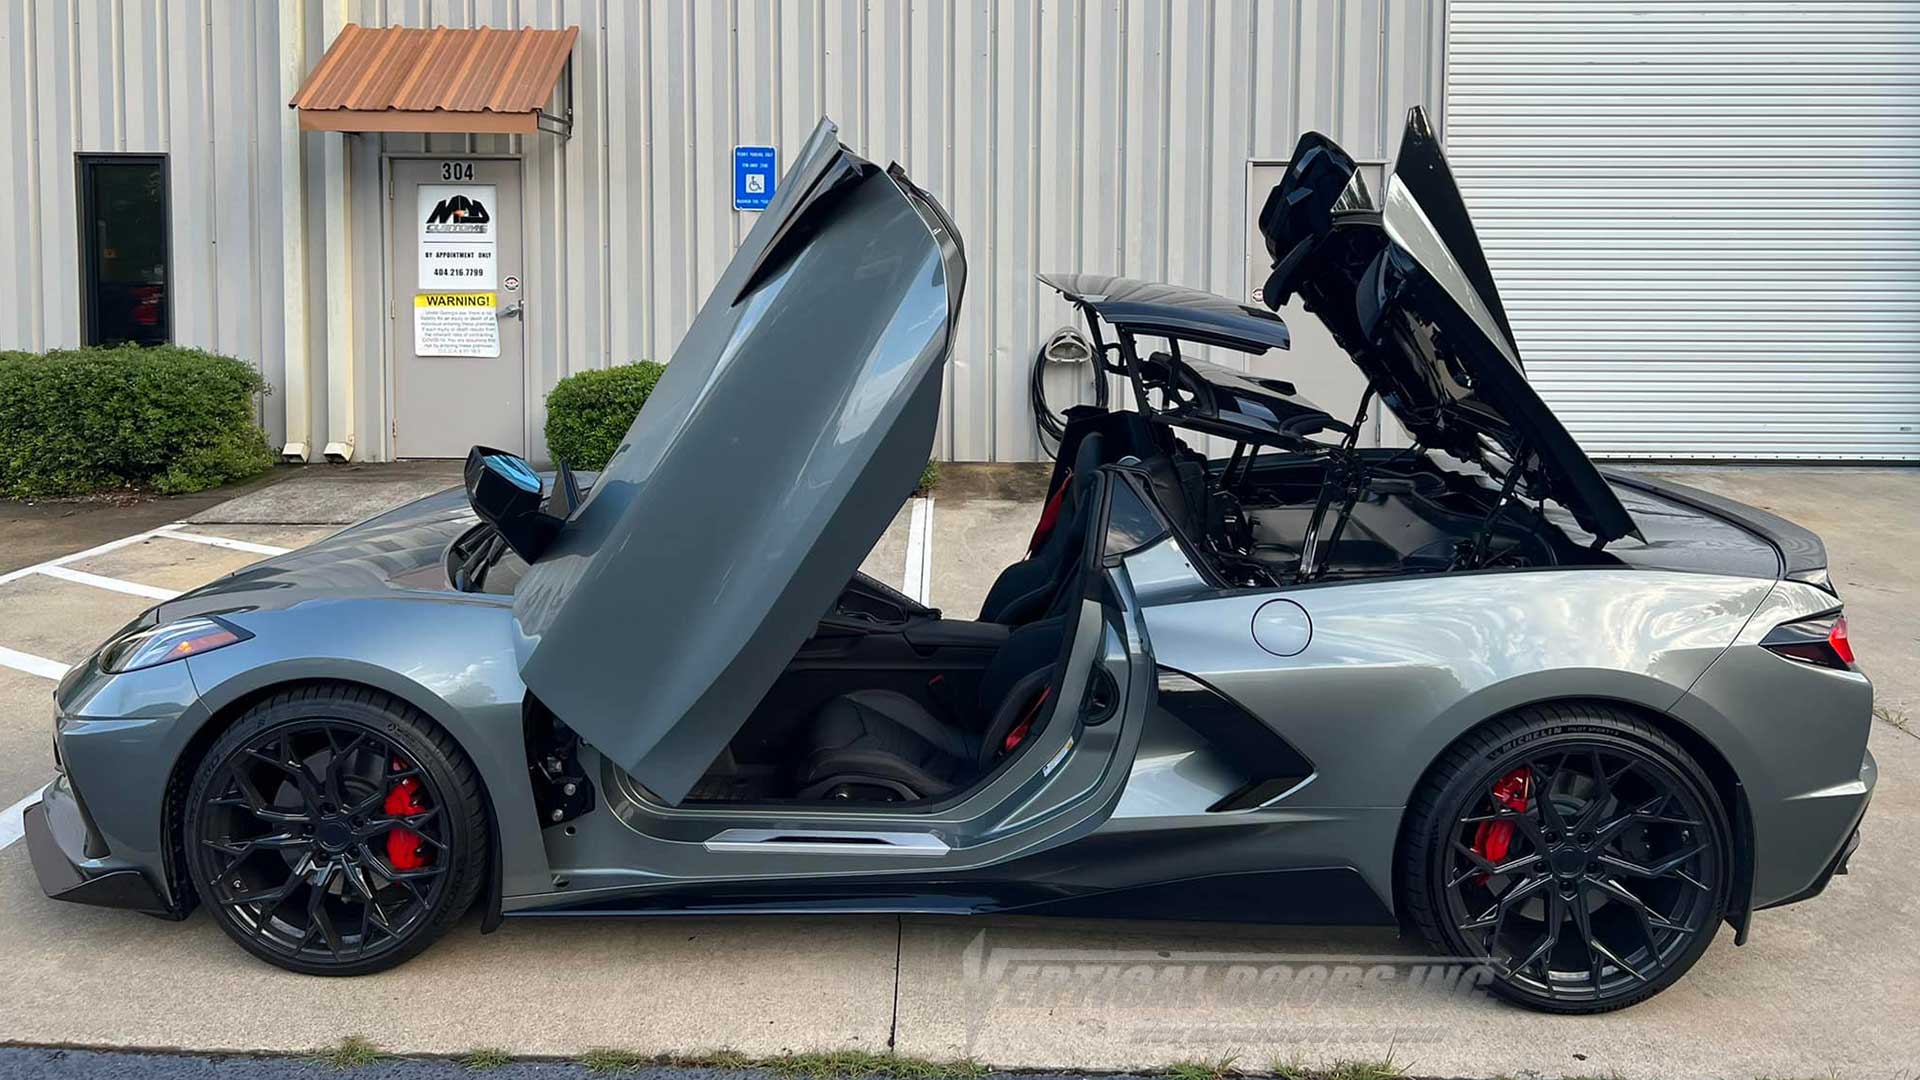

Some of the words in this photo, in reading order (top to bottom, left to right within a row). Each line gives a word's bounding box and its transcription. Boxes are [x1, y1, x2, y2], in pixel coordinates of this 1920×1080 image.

[442, 162, 474, 181] 304
[435, 251, 475, 259] APPOINTMENT
[426, 295, 490, 307] WARNING!
[1502, 726, 1563, 752] MICHELIN
